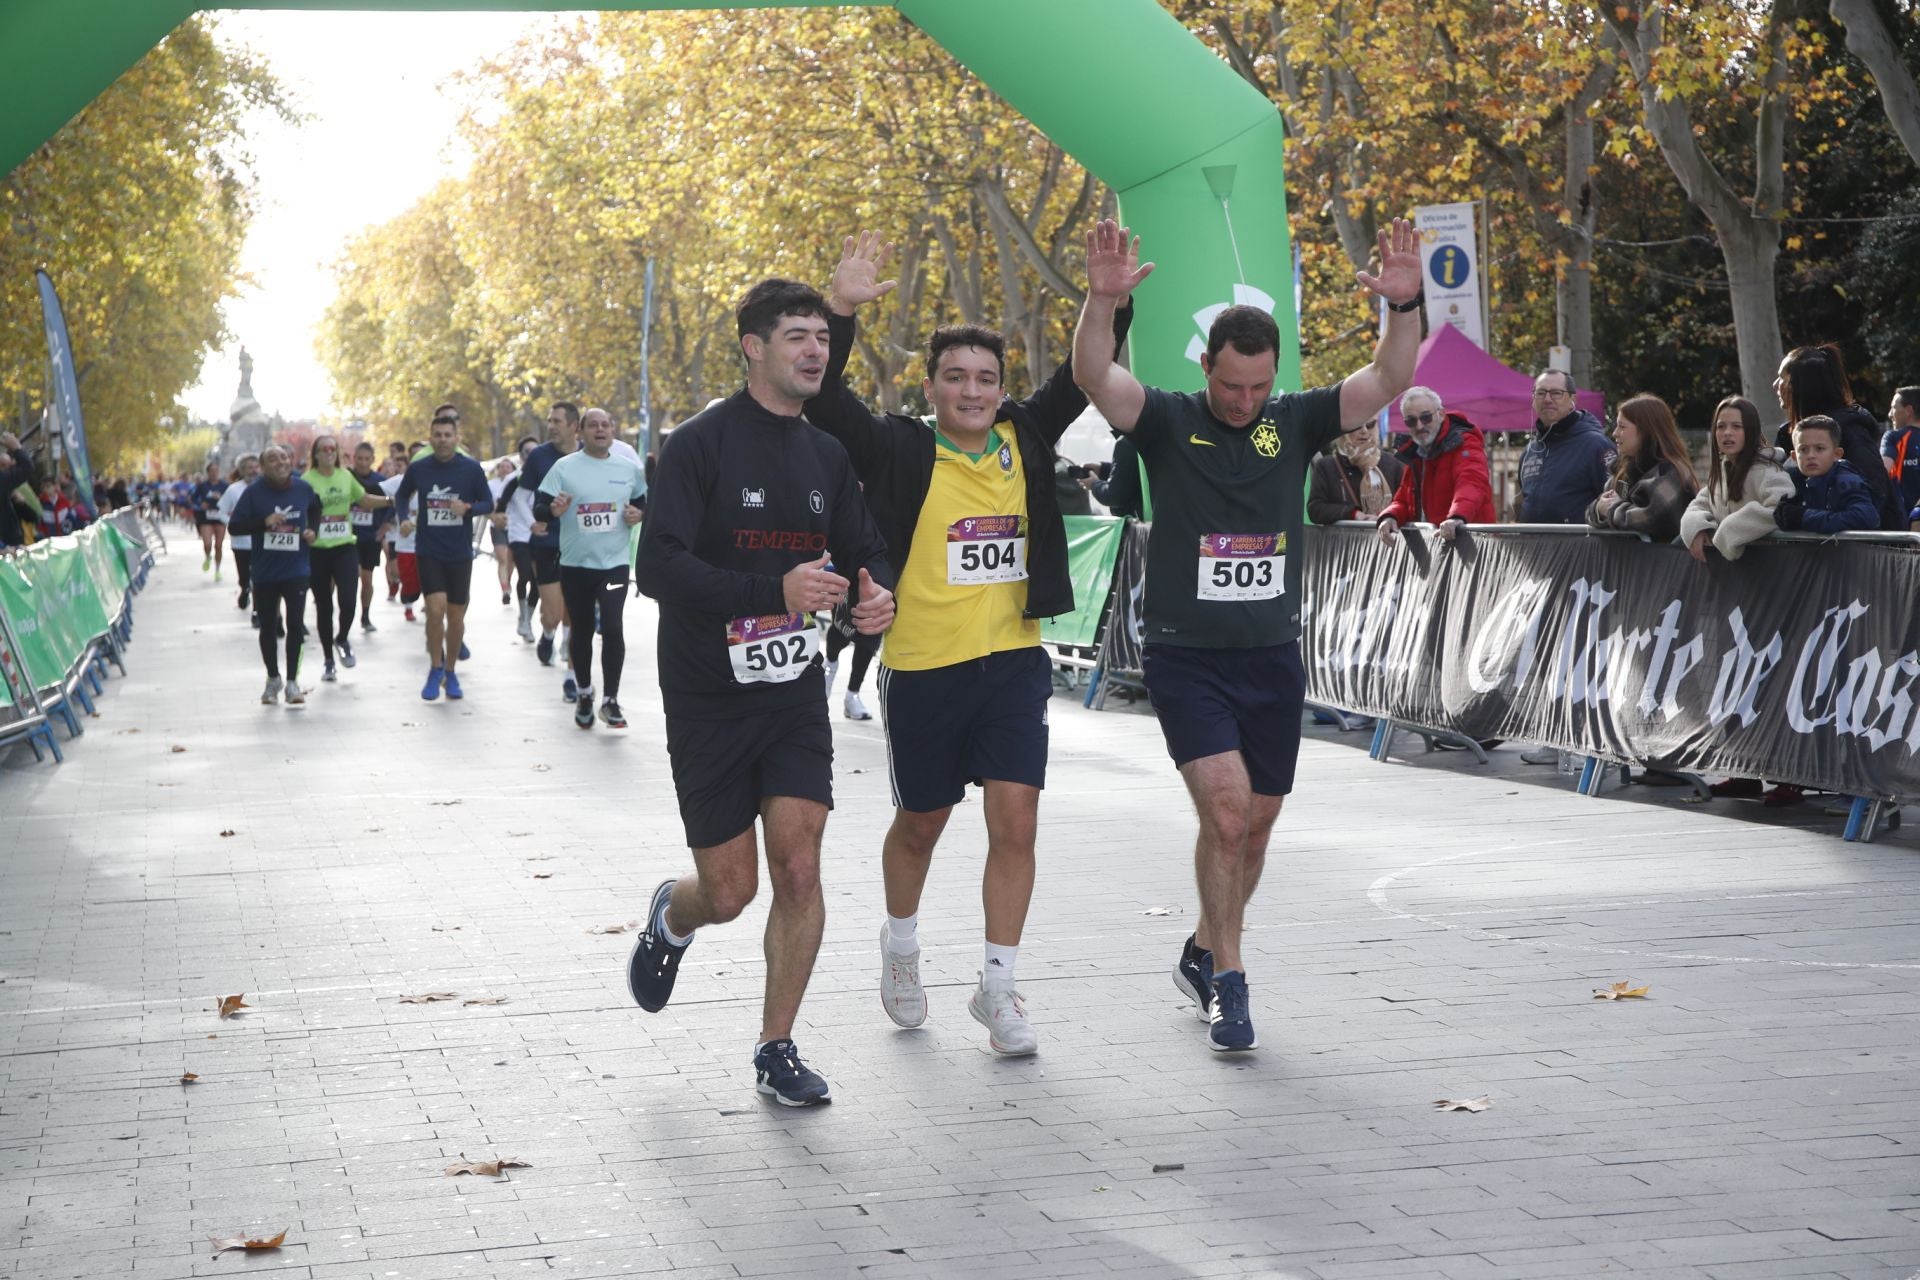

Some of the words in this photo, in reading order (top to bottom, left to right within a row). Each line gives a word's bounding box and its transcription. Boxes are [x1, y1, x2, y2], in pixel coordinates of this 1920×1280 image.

[1423, 214, 1447, 223] Oficina
[583, 514, 610, 527] 801
[324, 522, 346, 533] 440
[976, 524, 1007, 533] EMPRESAS
[270, 534, 294, 545] 728
[1231, 542, 1264, 551] EMPRESAS
[960, 542, 1015, 571] 504
[1211, 560, 1272, 587] 503
[757, 618, 789, 631] EMPRESAS
[745, 635, 810, 671] 502
[1548, 576, 1704, 723] Norte
[1706, 606, 1783, 729] de
[1786, 598, 1920, 757] Cas
